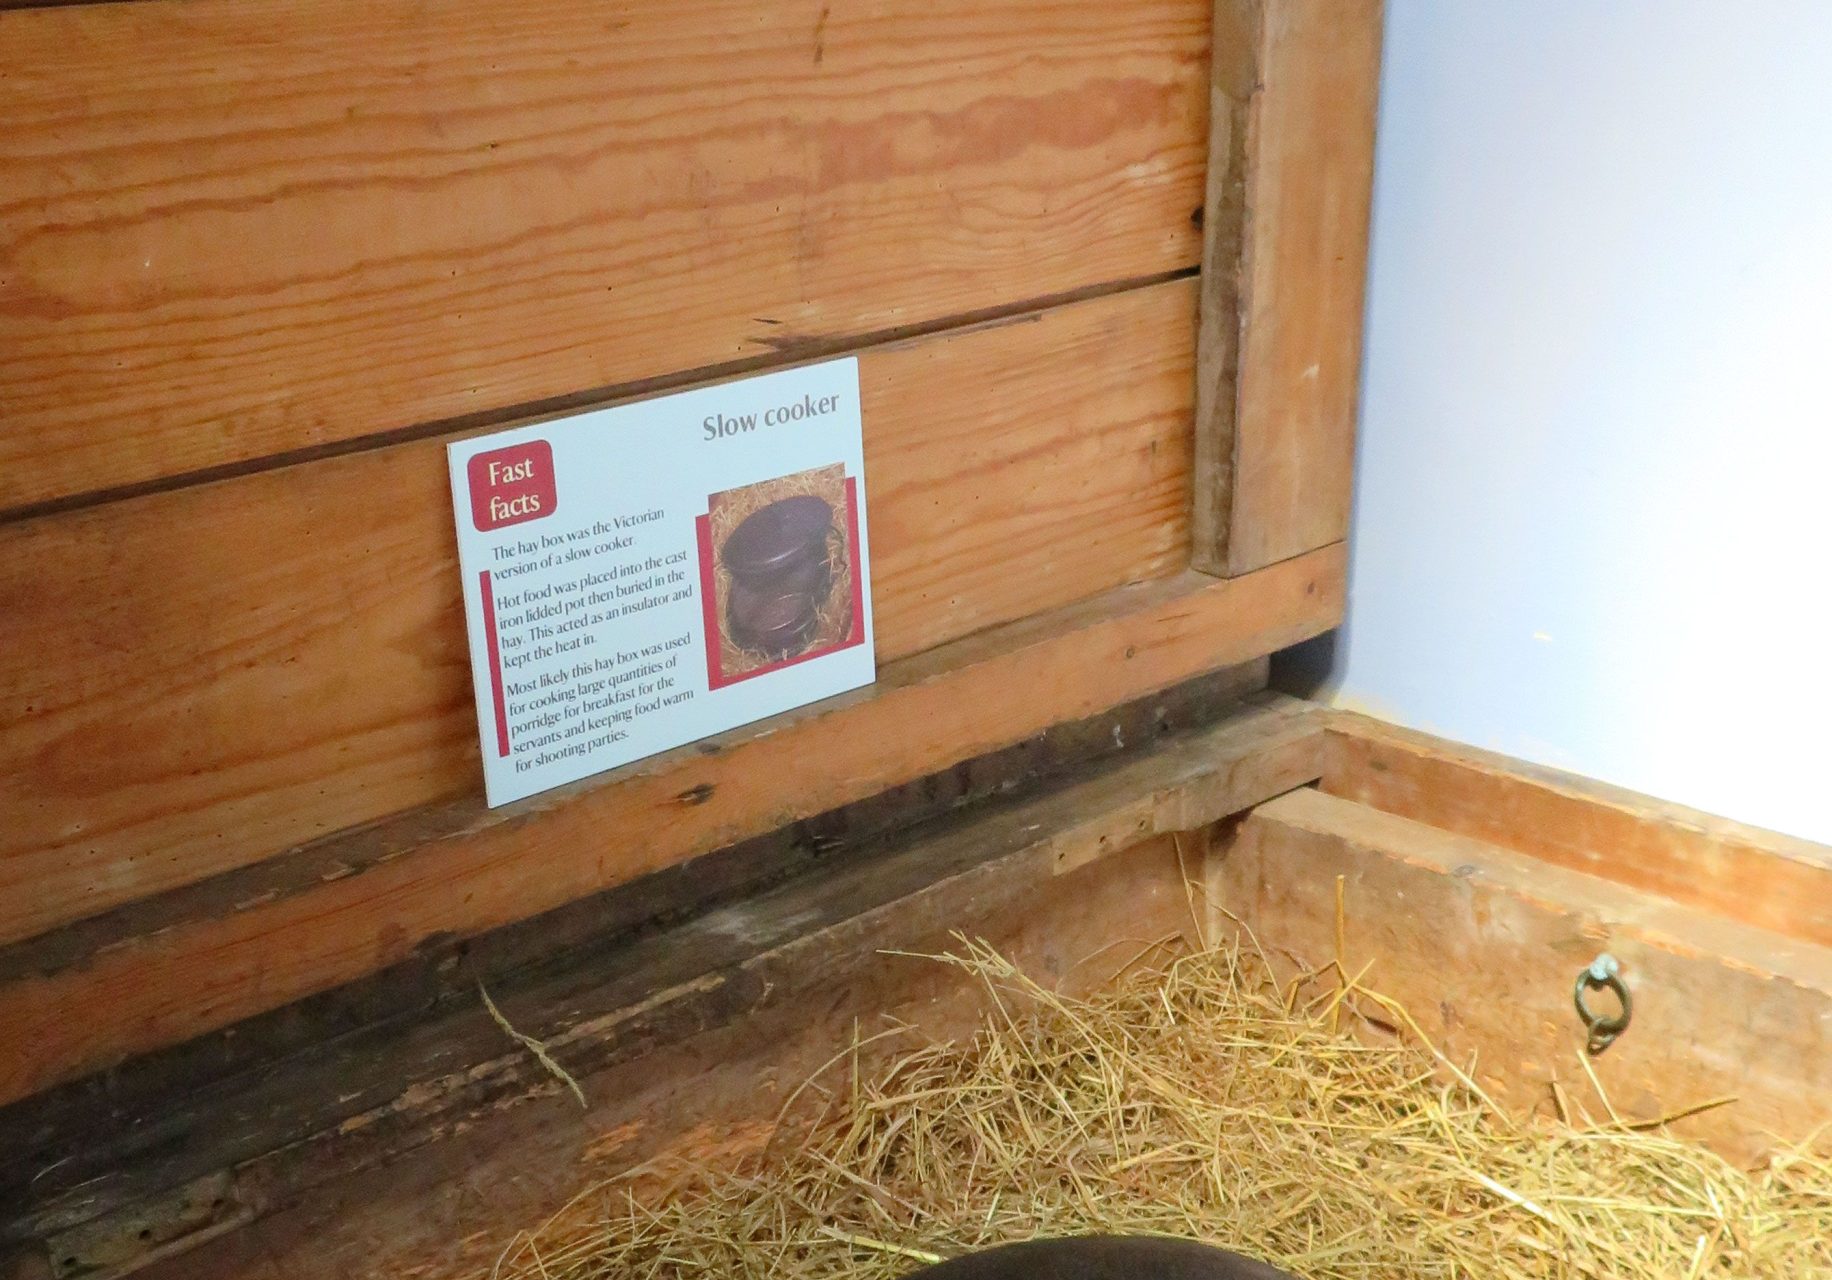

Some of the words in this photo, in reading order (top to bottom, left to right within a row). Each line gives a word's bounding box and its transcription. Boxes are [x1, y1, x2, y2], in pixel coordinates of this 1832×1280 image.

[703, 415, 757, 441] Slow
[764, 392, 839, 426] cooker
[489, 458, 533, 486] Fast
[489, 493, 540, 522] facts
[492, 547, 515, 561] The
[518, 541, 539, 556] hay
[541, 534, 565, 547] box
[567, 528, 590, 541] was
[593, 521, 611, 535] the
[613, 509, 664, 529] Victorian
[494, 561, 537, 580] version
[540, 554, 553, 568] of
[555, 556, 562, 565] a
[565, 547, 590, 562] slow
[594, 535, 636, 554] cooker.
[498, 595, 520, 610] Hot
[524, 585, 551, 603] food
[554, 581, 577, 594] was
[580, 568, 617, 590] placed
[620, 563, 642, 578] into
[645, 557, 662, 571] the
[665, 551, 687, 565] cast
[500, 614, 522, 629] iron
[526, 601, 562, 622] lidded
[565, 599, 585, 615] pot
[588, 592, 614, 606] then
[616, 577, 652, 597] buried
[655, 576, 664, 586] in
[667, 570, 685, 584] the
[501, 635, 525, 649] hay.
[529, 628, 554, 641] This
[557, 615, 588, 634] acted
[591, 613, 603, 624] as
[606, 608, 619, 620] an
[622, 594, 669, 615] insulator
[672, 585, 692, 600] and
[503, 654, 531, 669] kept
[534, 646, 552, 660] the
[555, 640, 580, 654] heat
[584, 634, 596, 645] in.
[507, 681, 542, 697] Most
[540, 671, 569, 686] likely
[572, 661, 593, 677] this
[595, 655, 615, 670] hay
[617, 651, 639, 664] box
[641, 644, 662, 657] was
[665, 633, 690, 649] used
[509, 704, 526, 716] for
[530, 691, 576, 710] cooking
[578, 680, 605, 697] large
[608, 661, 663, 686] quantities
[666, 655, 677, 668] of
[511, 713, 561, 738] porridge
[564, 706, 580, 719] for
[584, 689, 635, 712] breakfast
[639, 684, 653, 696] for
[657, 677, 674, 690] the
[513, 733, 562, 754] servants
[565, 722, 585, 738] and
[588, 709, 632, 731] keeping
[635, 701, 660, 716] food
[663, 690, 694, 707] warm
[515, 761, 532, 772] for
[535, 743, 585, 766] shooting
[588, 730, 628, 753] parties.
